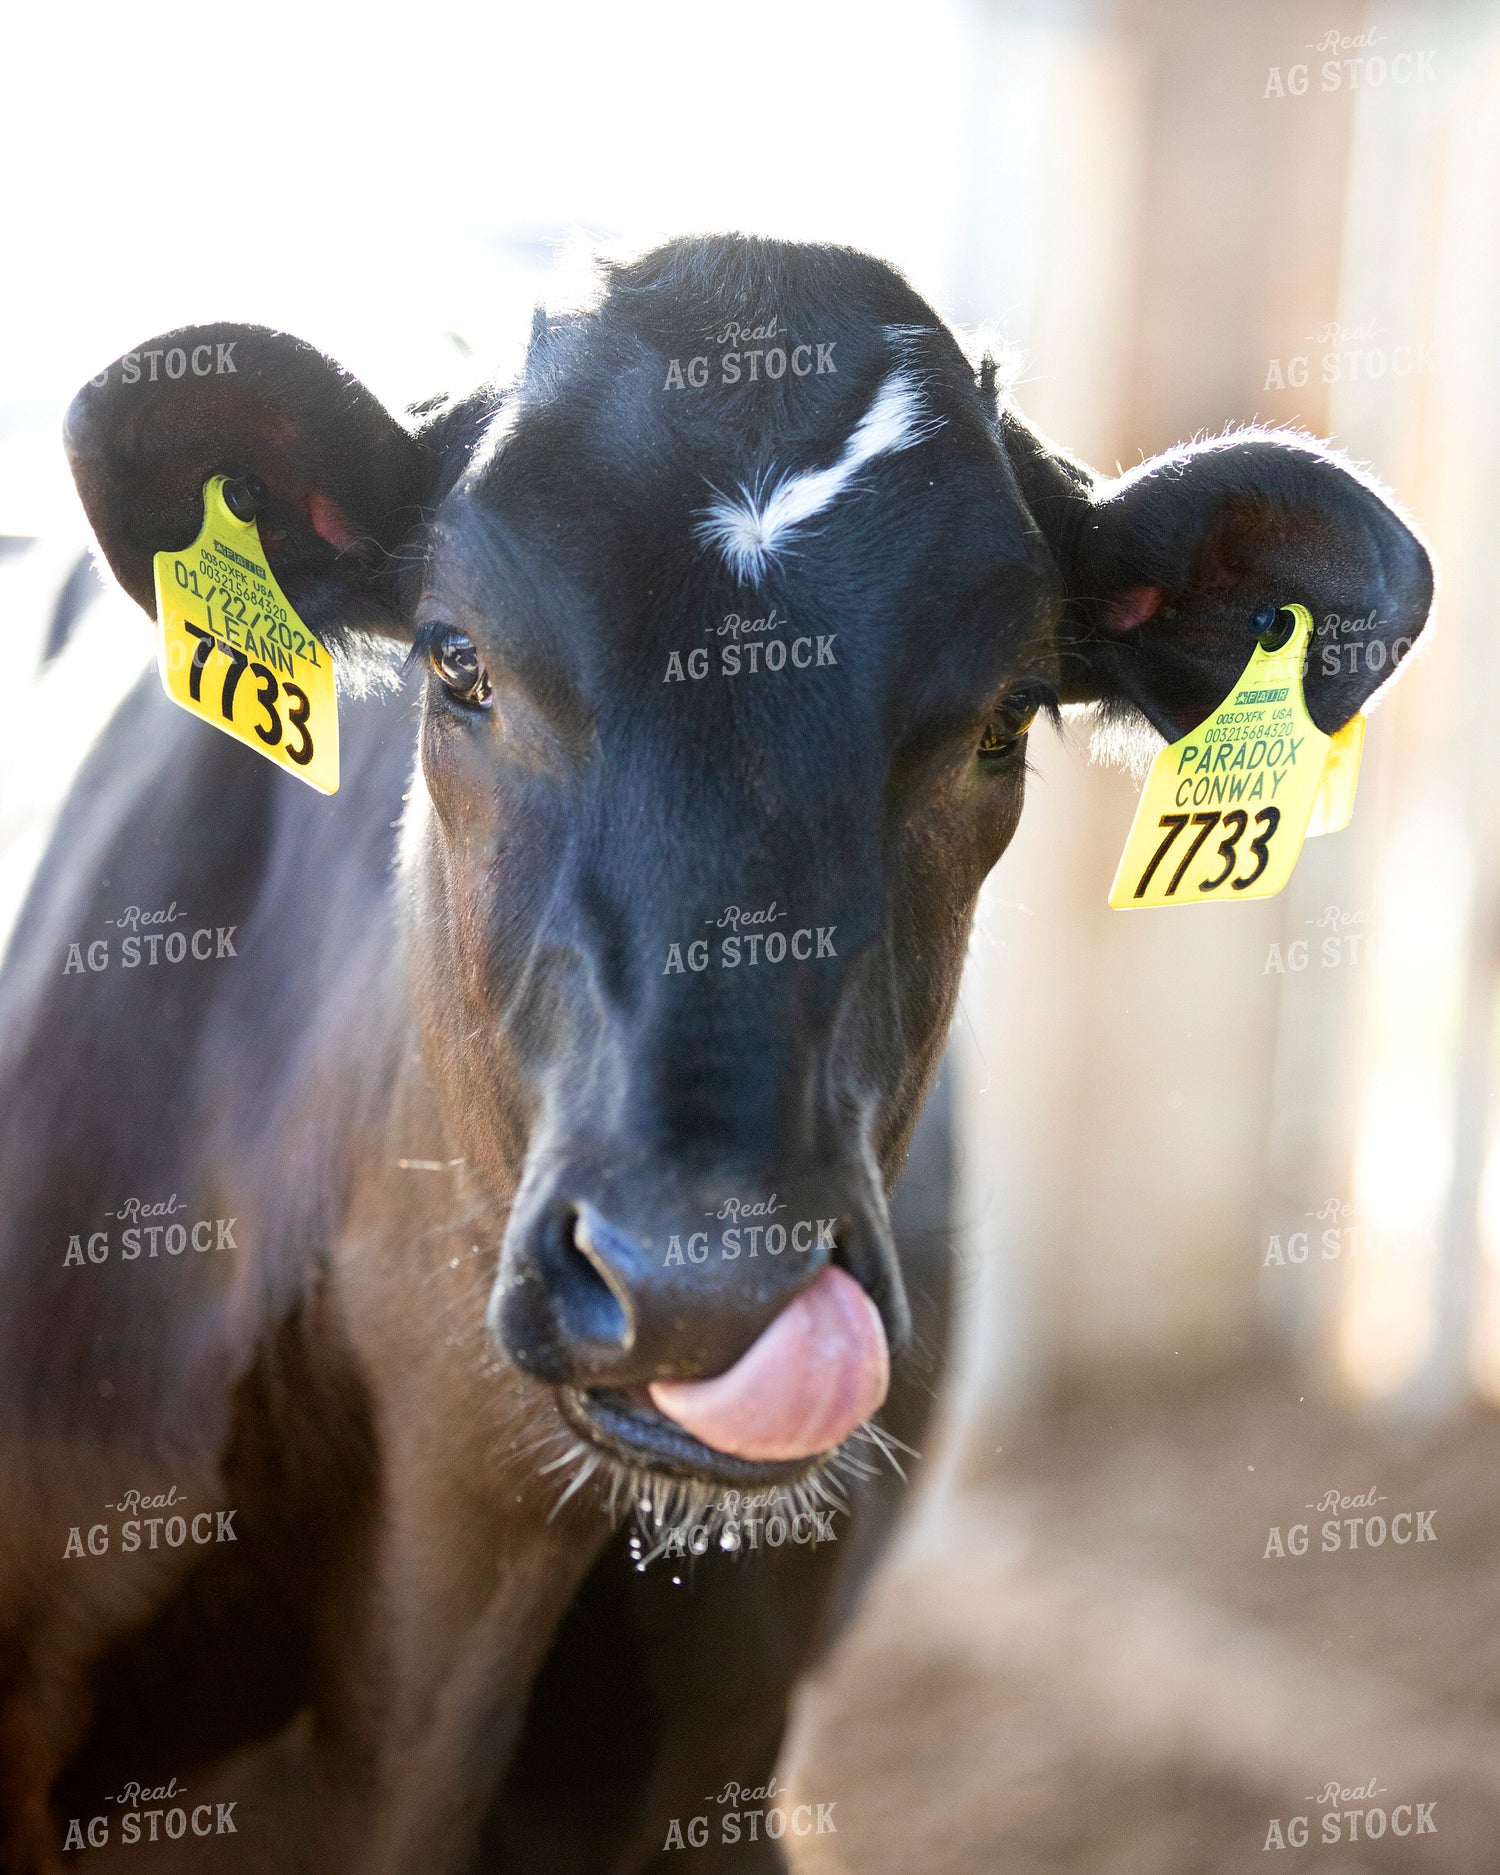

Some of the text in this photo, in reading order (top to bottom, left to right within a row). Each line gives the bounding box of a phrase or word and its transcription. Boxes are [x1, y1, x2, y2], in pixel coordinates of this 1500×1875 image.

[175, 560, 321, 668] 01/22/2021
[200, 561, 287, 622] 003215684320
[253, 580, 275, 601] USA
[207, 605, 294, 678] LEANN
[184, 619, 314, 766] 7733
[1272, 708, 1292, 720] USA
[1177, 737, 1305, 775] PARADOX
[1205, 722, 1294, 743] 003215684320
[1175, 769, 1287, 807] CONWAY
[1133, 806, 1281, 899] 7733
